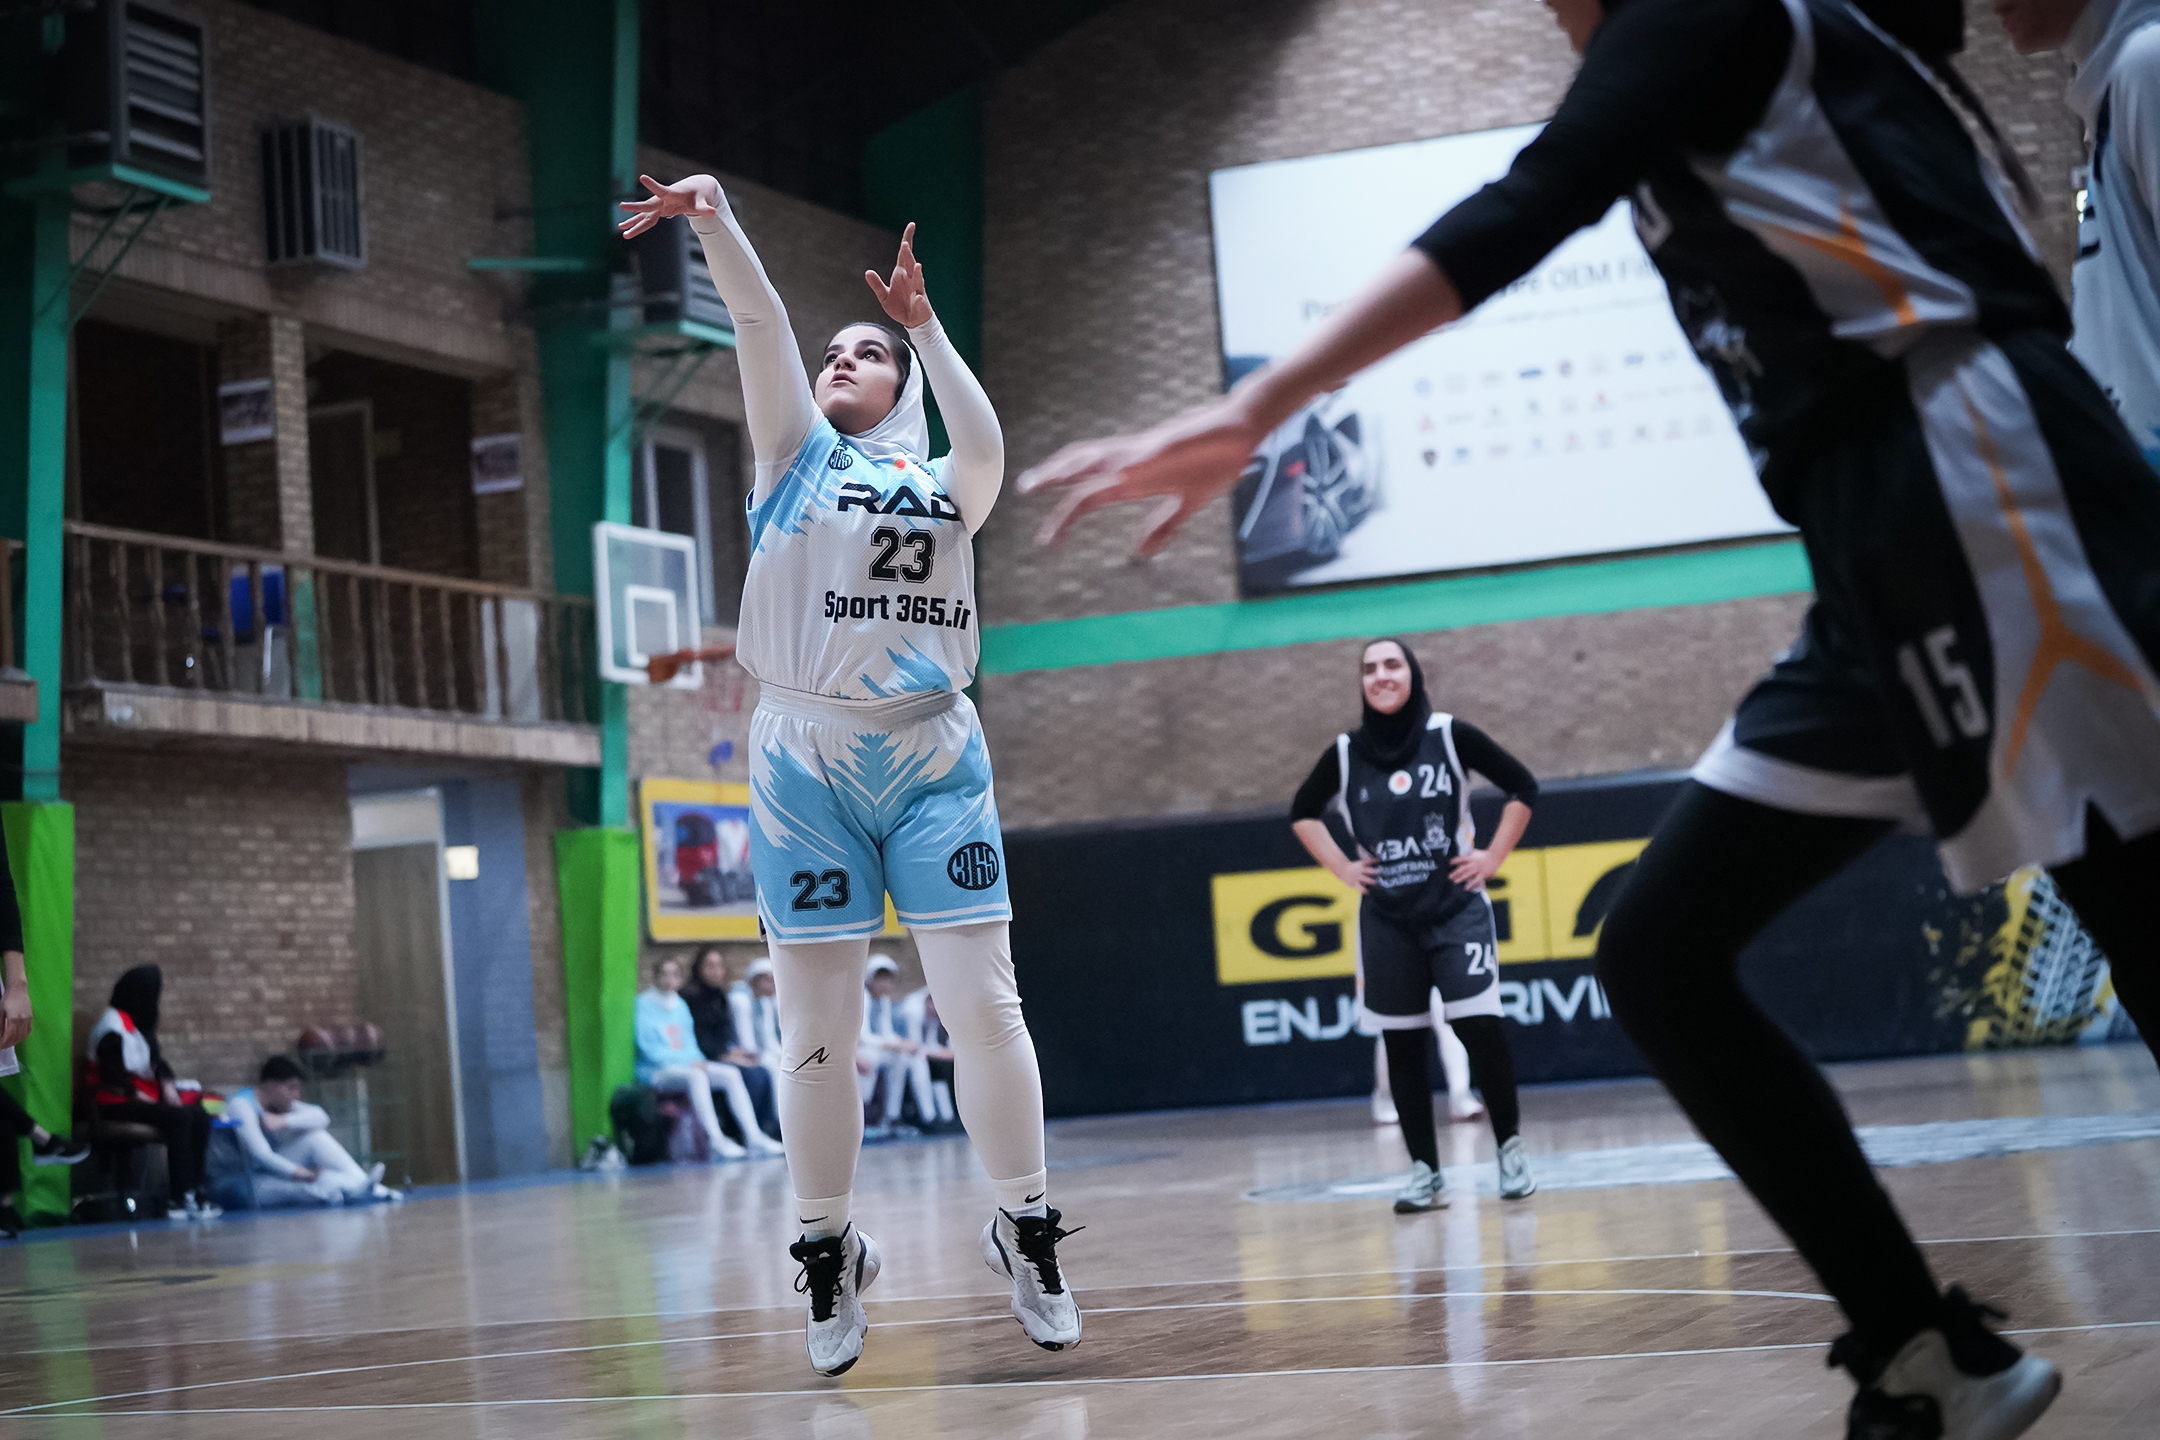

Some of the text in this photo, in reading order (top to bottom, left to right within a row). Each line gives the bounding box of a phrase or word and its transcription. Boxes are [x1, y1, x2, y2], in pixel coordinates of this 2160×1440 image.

[868, 526, 937, 584] 23
[824, 591, 972, 631] Sport 365.ir
[1898, 620, 1990, 750] 15
[1418, 762, 1453, 799] 24
[949, 843, 999, 890] 365
[790, 868, 851, 912] 23
[1465, 941, 1497, 976] 24
